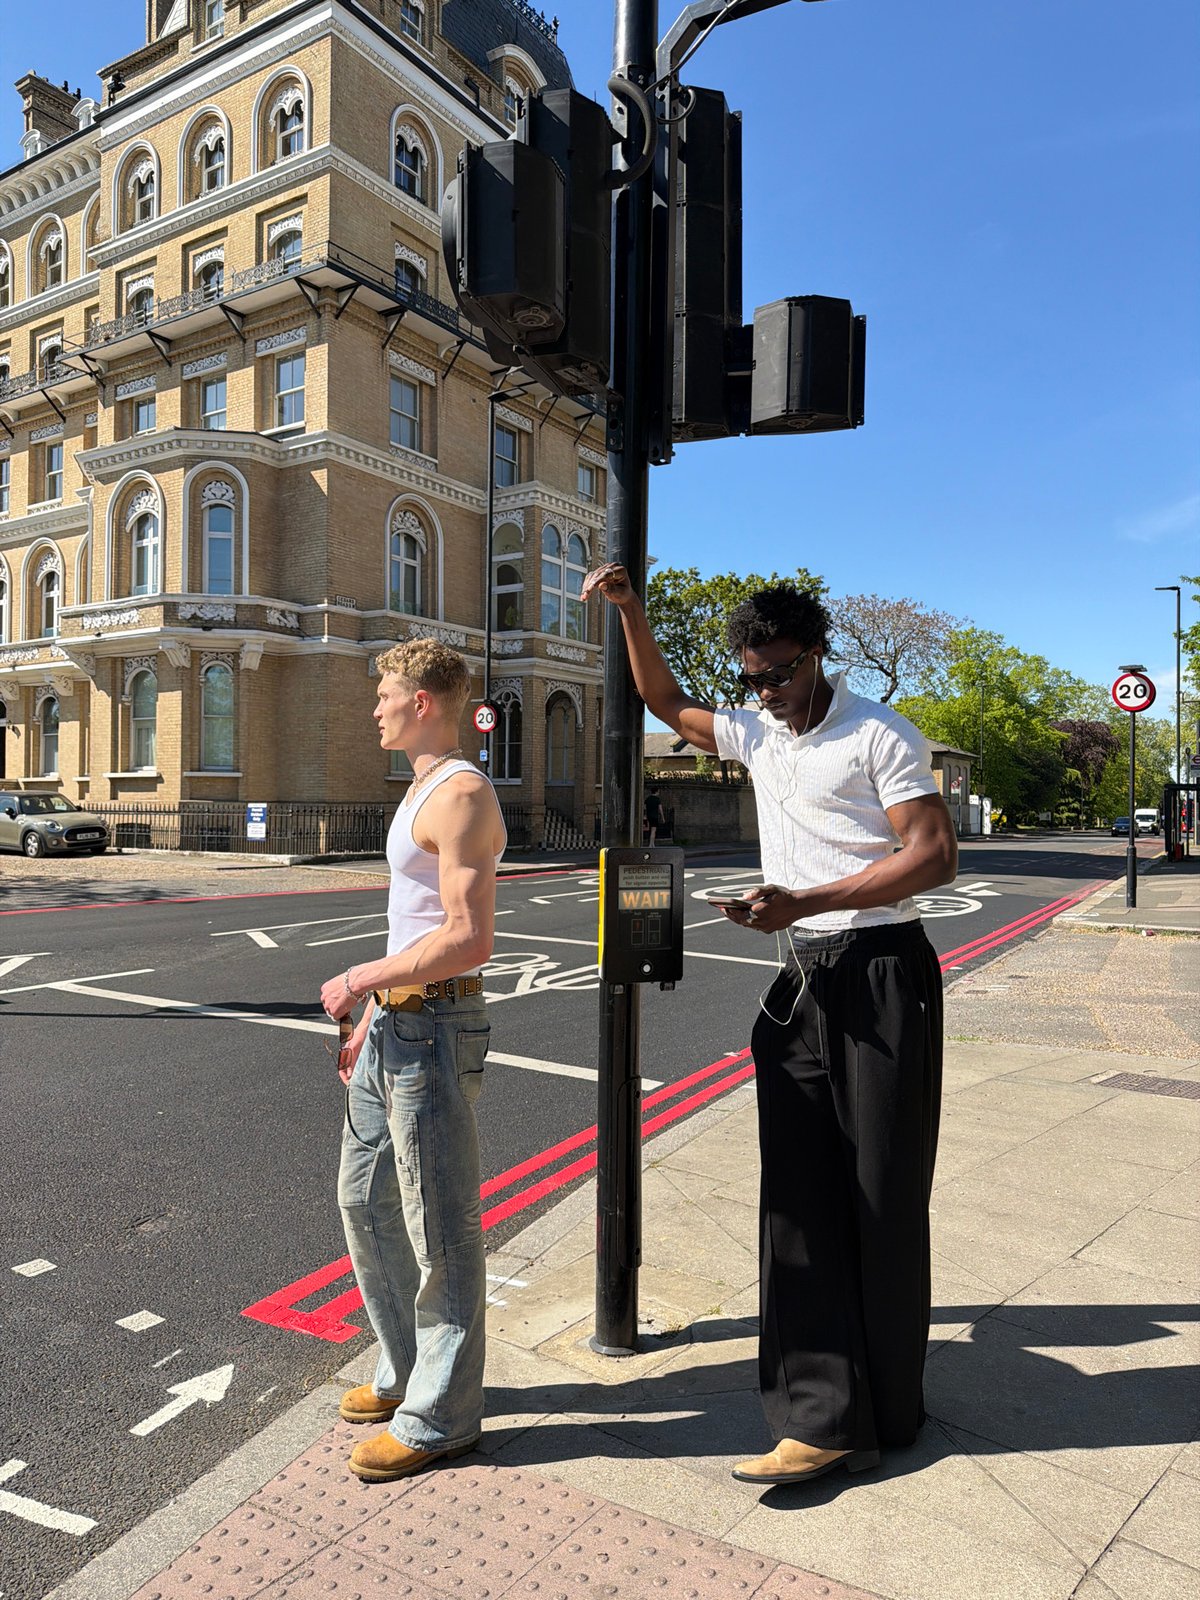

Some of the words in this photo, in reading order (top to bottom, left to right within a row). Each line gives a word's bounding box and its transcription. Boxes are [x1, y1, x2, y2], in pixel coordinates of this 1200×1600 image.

[1119, 684, 1147, 698] 20
[478, 712, 493, 724] 20
[623, 891, 670, 908] WAIT
